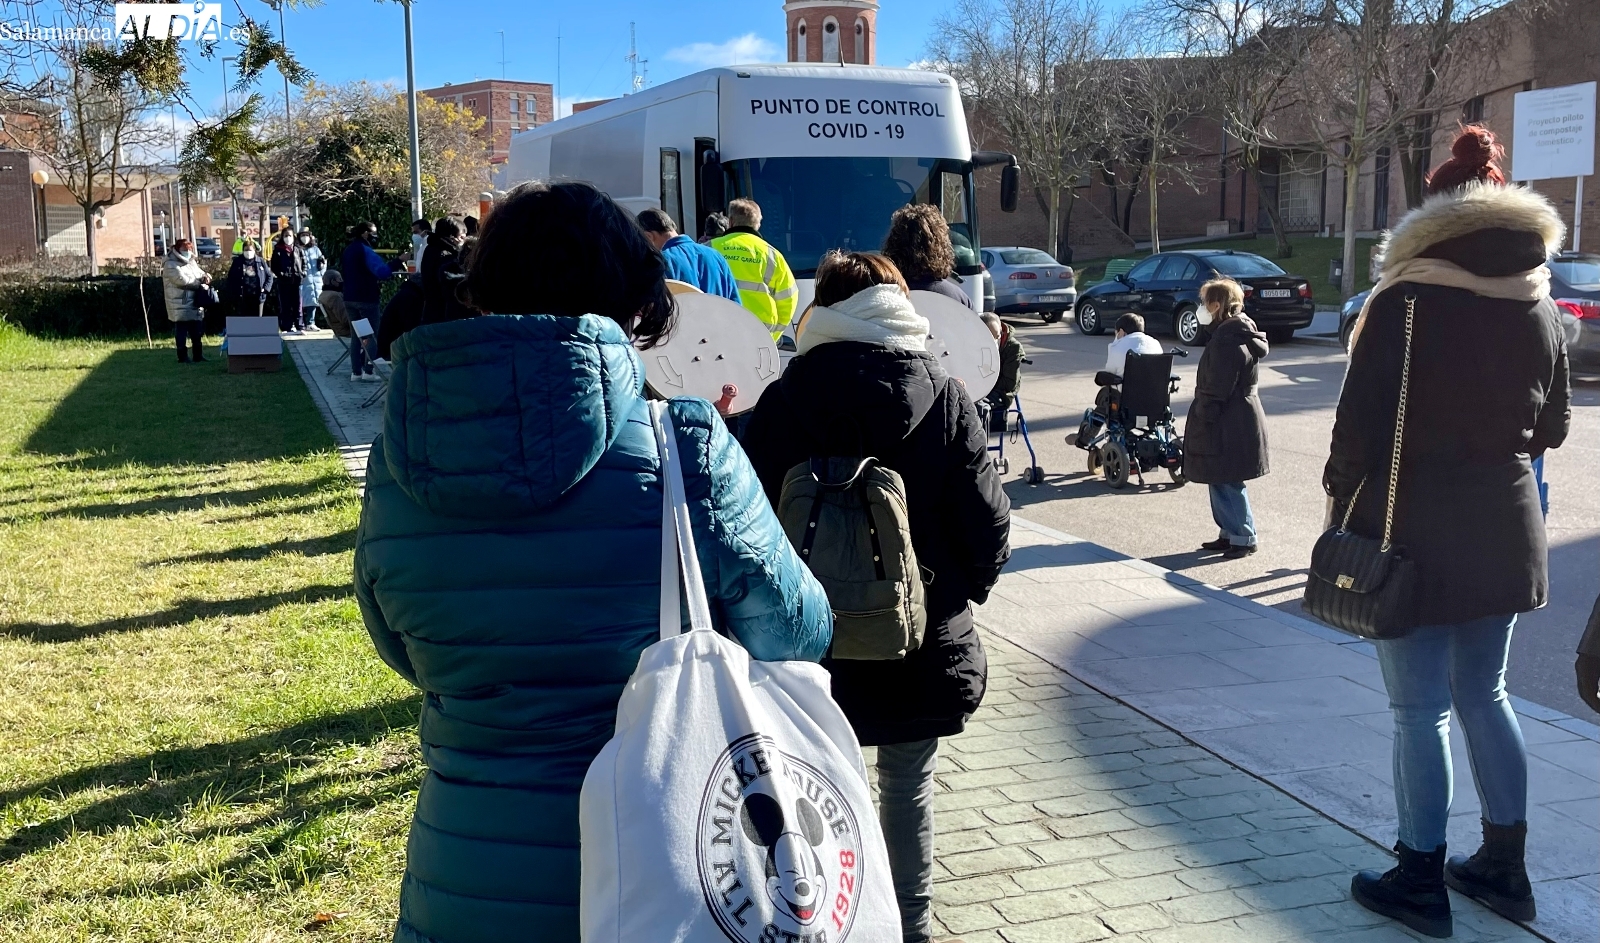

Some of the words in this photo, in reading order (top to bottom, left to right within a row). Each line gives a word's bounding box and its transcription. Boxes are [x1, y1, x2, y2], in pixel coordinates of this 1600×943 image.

[750, 98, 820, 115] PUNTO
[826, 99, 851, 115] DE
[857, 99, 946, 118] CONTROL
[1527, 117, 1560, 126] Proyecto
[1562, 113, 1584, 123] piloto
[807, 122, 868, 139] COVID
[884, 123, 905, 140] 19
[1528, 129, 1538, 138] de
[1539, 125, 1582, 135] compostaje
[711, 749, 774, 848] MICKE
[713, 858, 755, 928] ALL
[830, 849, 856, 933] 1928
